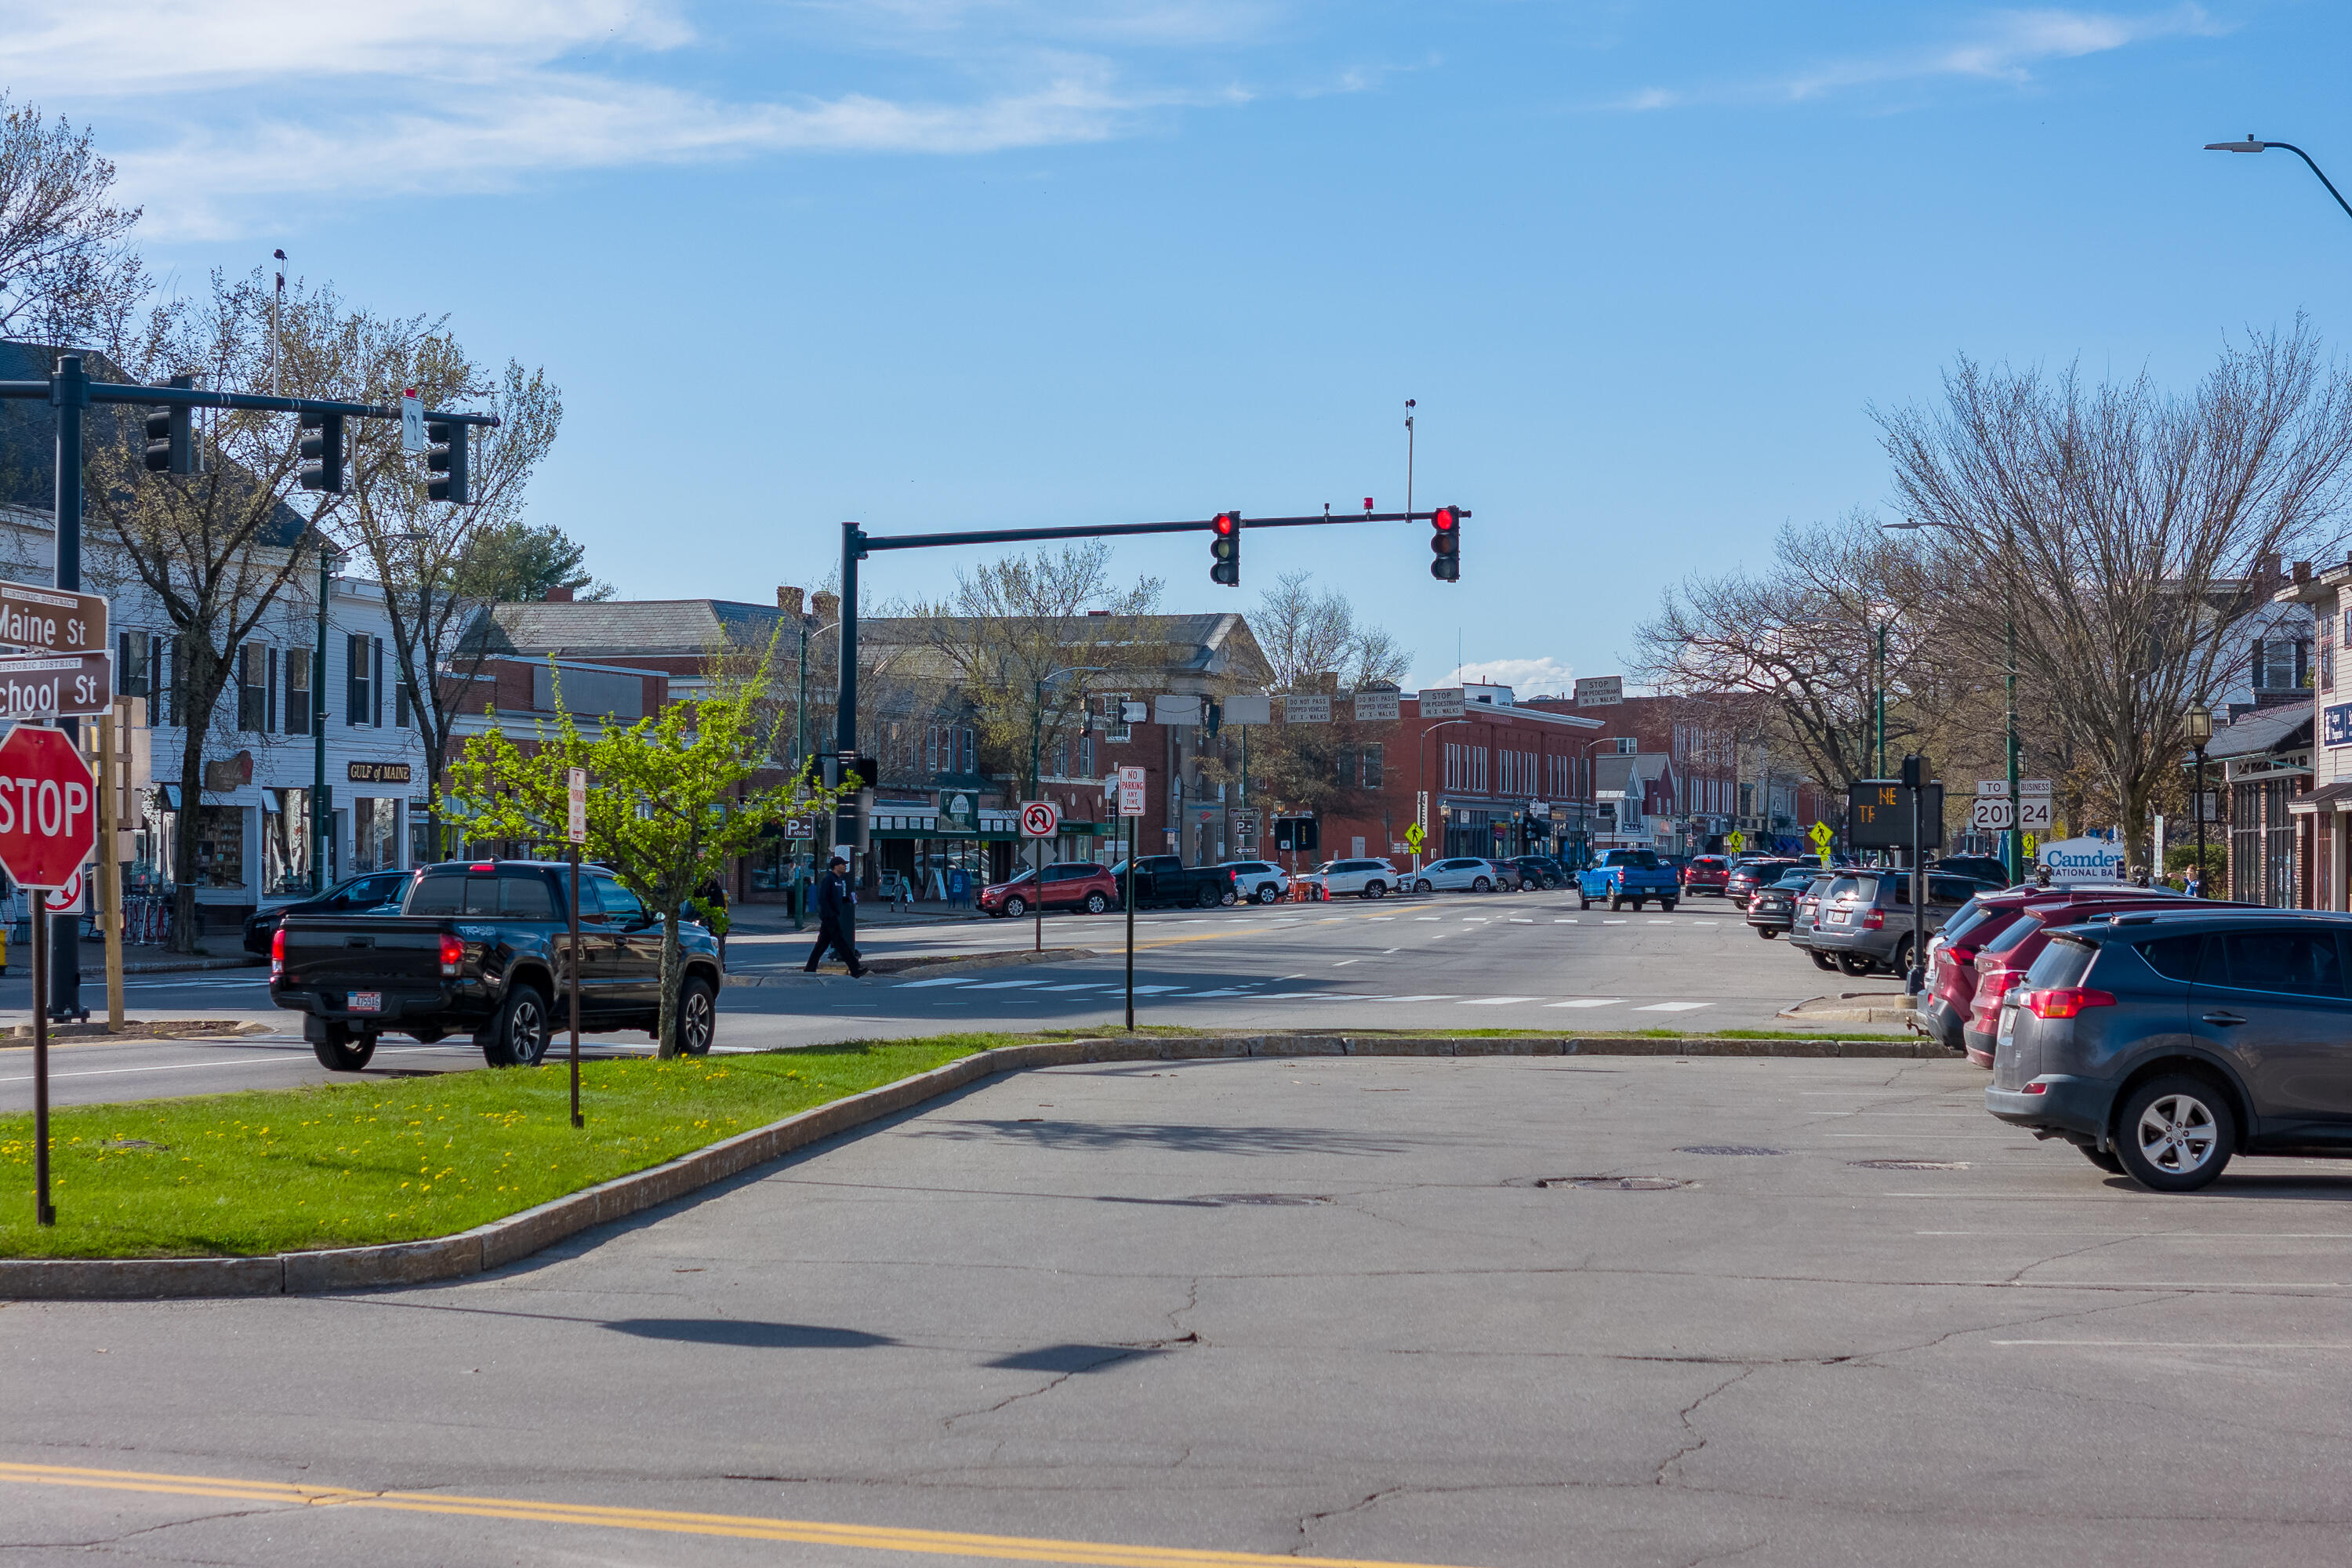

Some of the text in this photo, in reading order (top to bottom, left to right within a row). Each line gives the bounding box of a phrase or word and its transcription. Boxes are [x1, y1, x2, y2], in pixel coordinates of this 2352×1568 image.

[3, 589, 76, 608] HISTORIC DISTRICT
[67, 618, 86, 645] St
[39, 659, 79, 669] DISTRICT
[74, 675, 97, 704] St
[350, 764, 409, 782] GULF of MAINE
[1127, 771, 1138, 779] NO
[1122, 781, 1144, 790] PARKING
[1986, 782, 2001, 792] TO
[2020, 782, 2049, 791] BUSINESS
[0, 775, 88, 837] STOP
[1977, 805, 2009, 823] 201
[2023, 804, 2048, 822] 24
